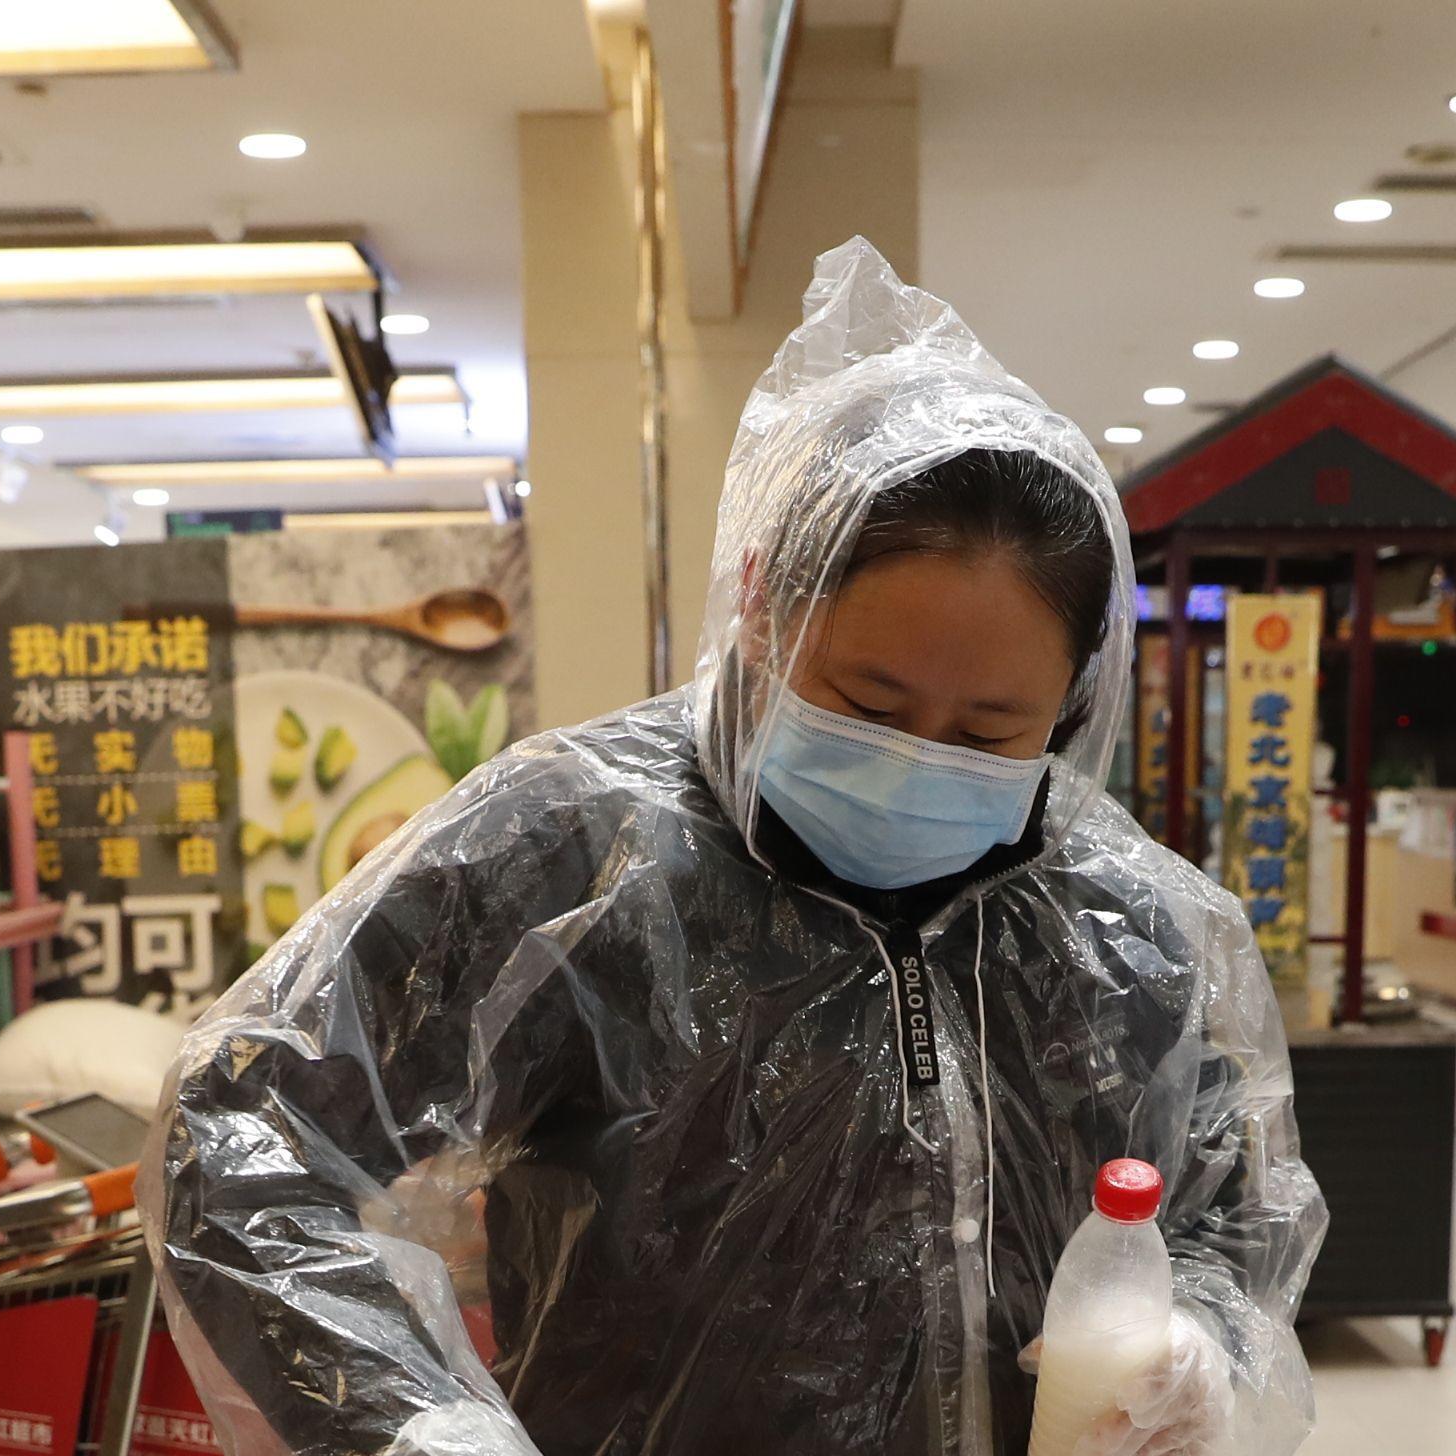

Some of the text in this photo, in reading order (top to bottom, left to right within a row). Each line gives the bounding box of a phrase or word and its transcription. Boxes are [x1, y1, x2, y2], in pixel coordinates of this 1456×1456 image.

[10, 616, 209, 679] 我们承诺
[14, 676, 212, 724] 水果不好吃
[902, 956, 934, 1080] SOLO CELEB
